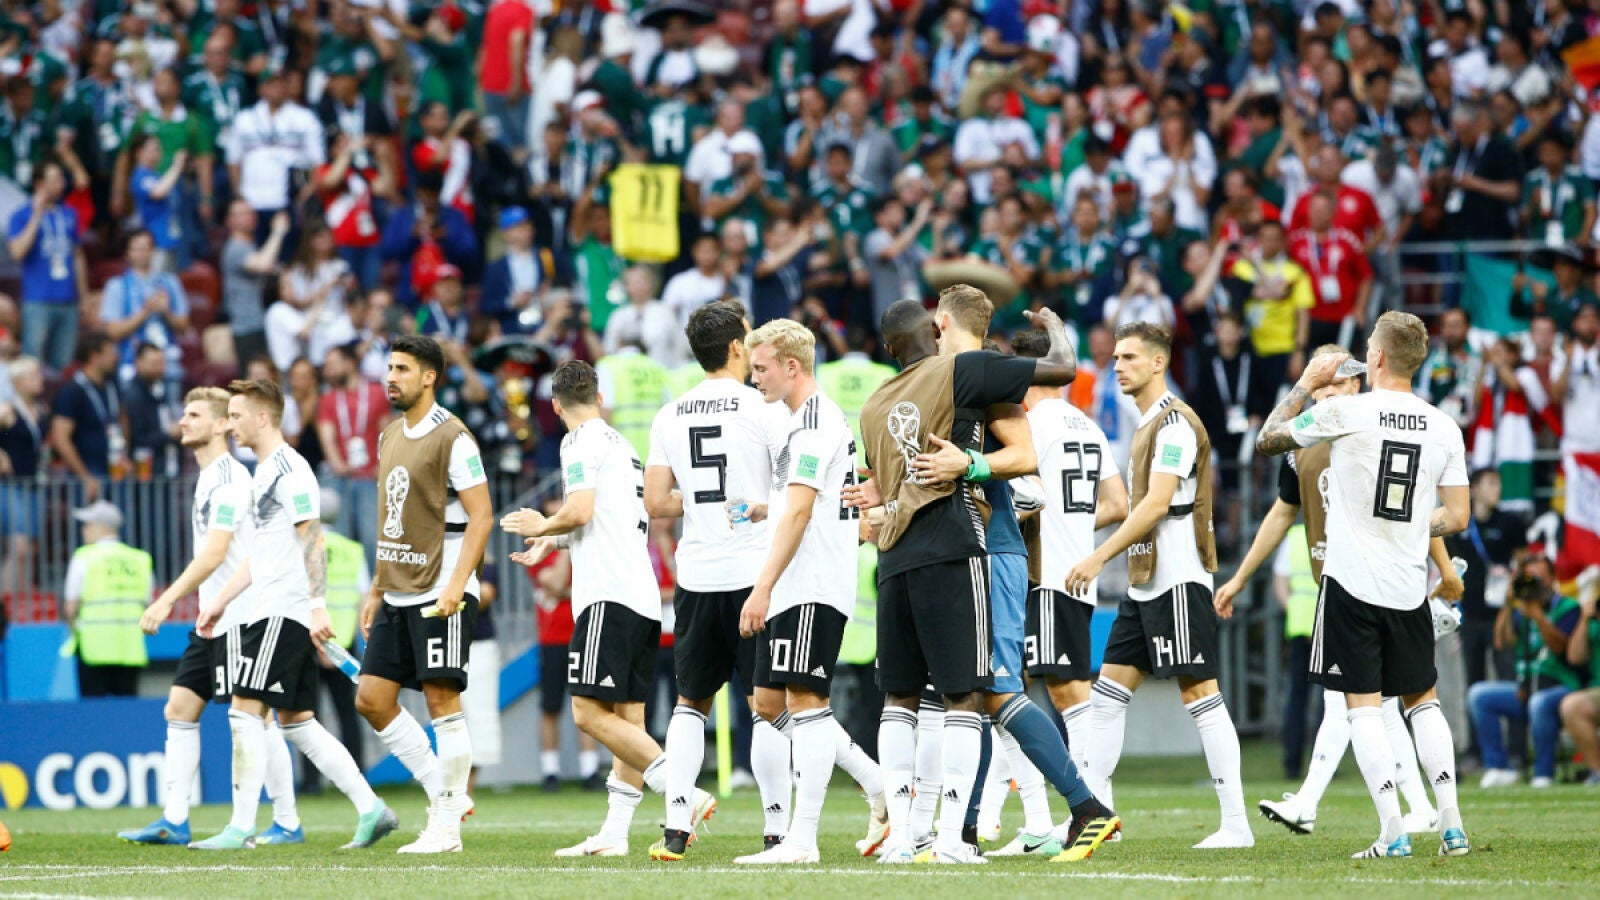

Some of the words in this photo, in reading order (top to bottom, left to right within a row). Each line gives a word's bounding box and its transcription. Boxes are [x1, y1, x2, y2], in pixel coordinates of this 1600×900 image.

[676, 397, 739, 416] HUMMELS
[1379, 411, 1427, 431] KROOS
[689, 425, 727, 504] 5
[1061, 441, 1102, 515] 23
[1373, 440, 1421, 523] 8
[399, 551, 428, 565] 2018
[427, 637, 444, 669] 6
[1151, 635, 1174, 668] 14
[215, 665, 226, 696] 9
